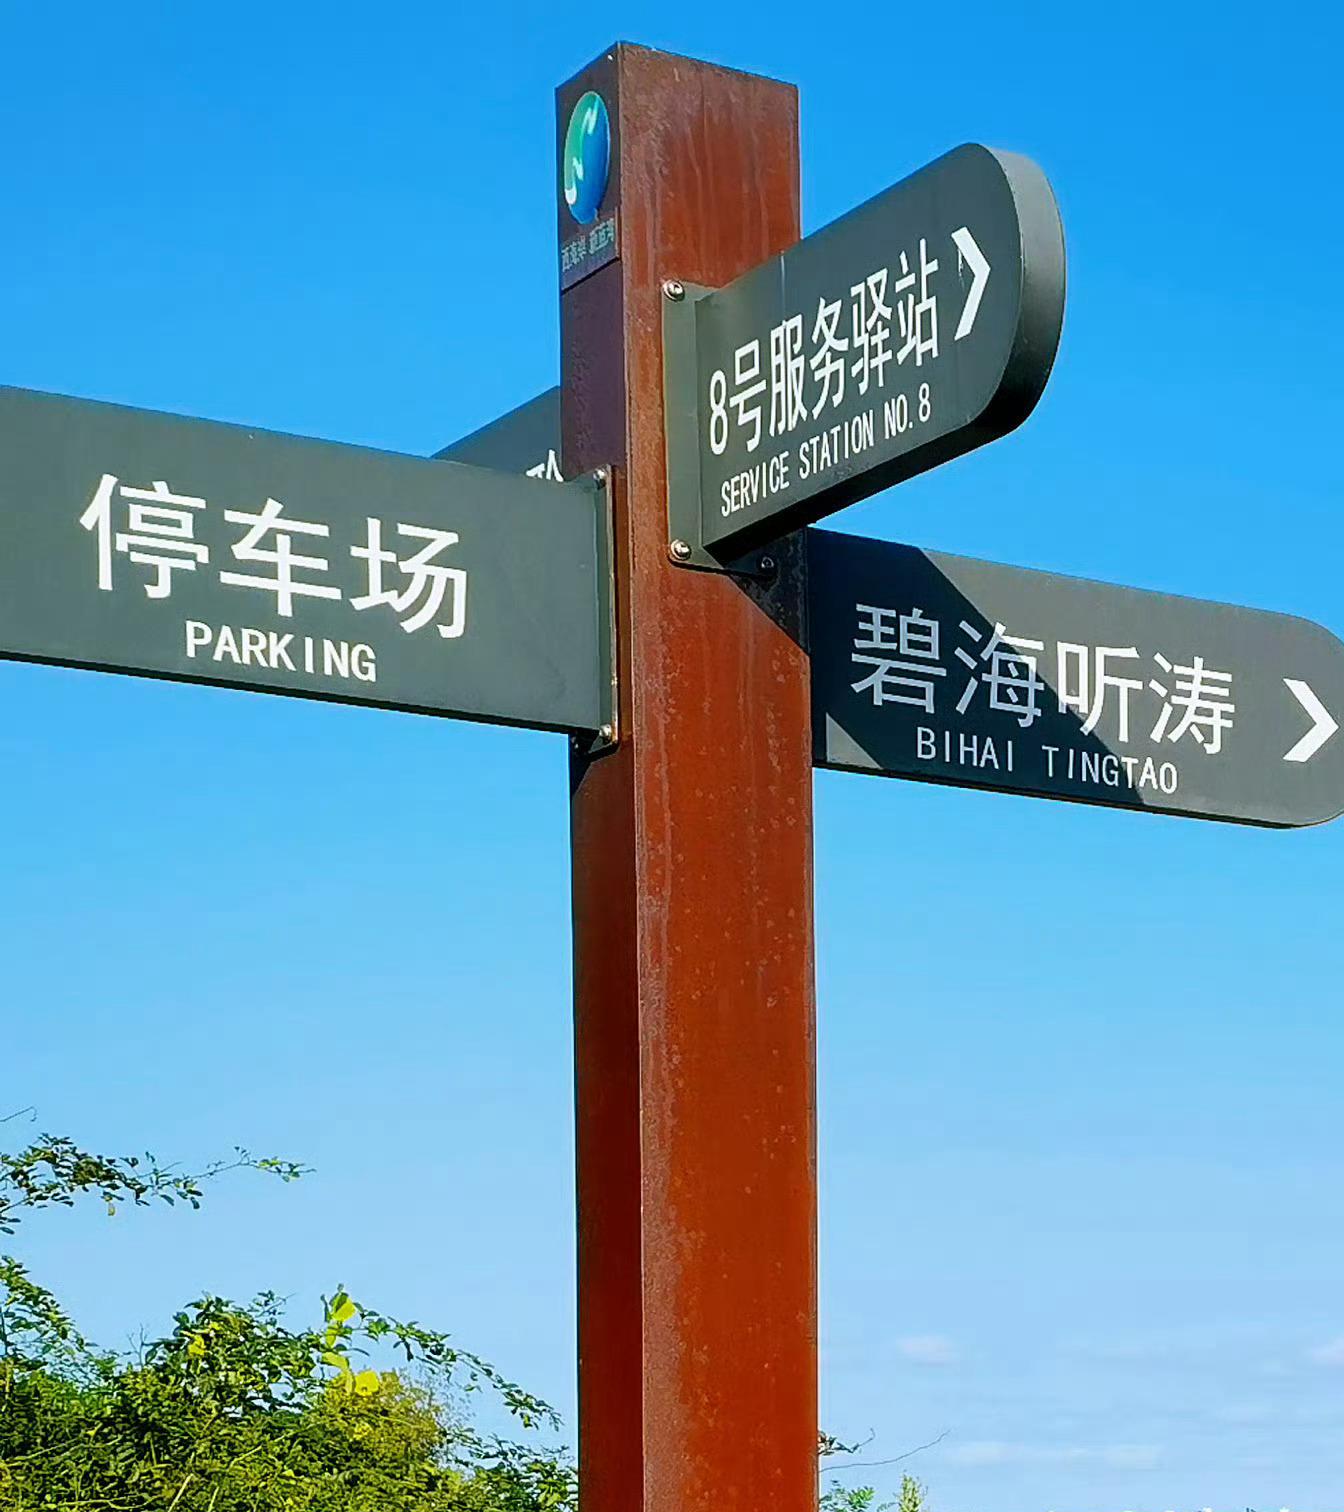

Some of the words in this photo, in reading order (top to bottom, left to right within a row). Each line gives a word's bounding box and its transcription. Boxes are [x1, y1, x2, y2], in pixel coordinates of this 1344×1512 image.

[710, 238, 939, 455] 8号服务驿站
[721, 450, 790, 517] SERVICE
[799, 415, 873, 480] STATION
[80, 473, 467, 639] 停车场
[185, 619, 377, 683] PARKING
[850, 603, 1236, 756] 碧海听涛
[916, 726, 1014, 772] BIHAI
[1041, 745, 1178, 795] TINGTAO
